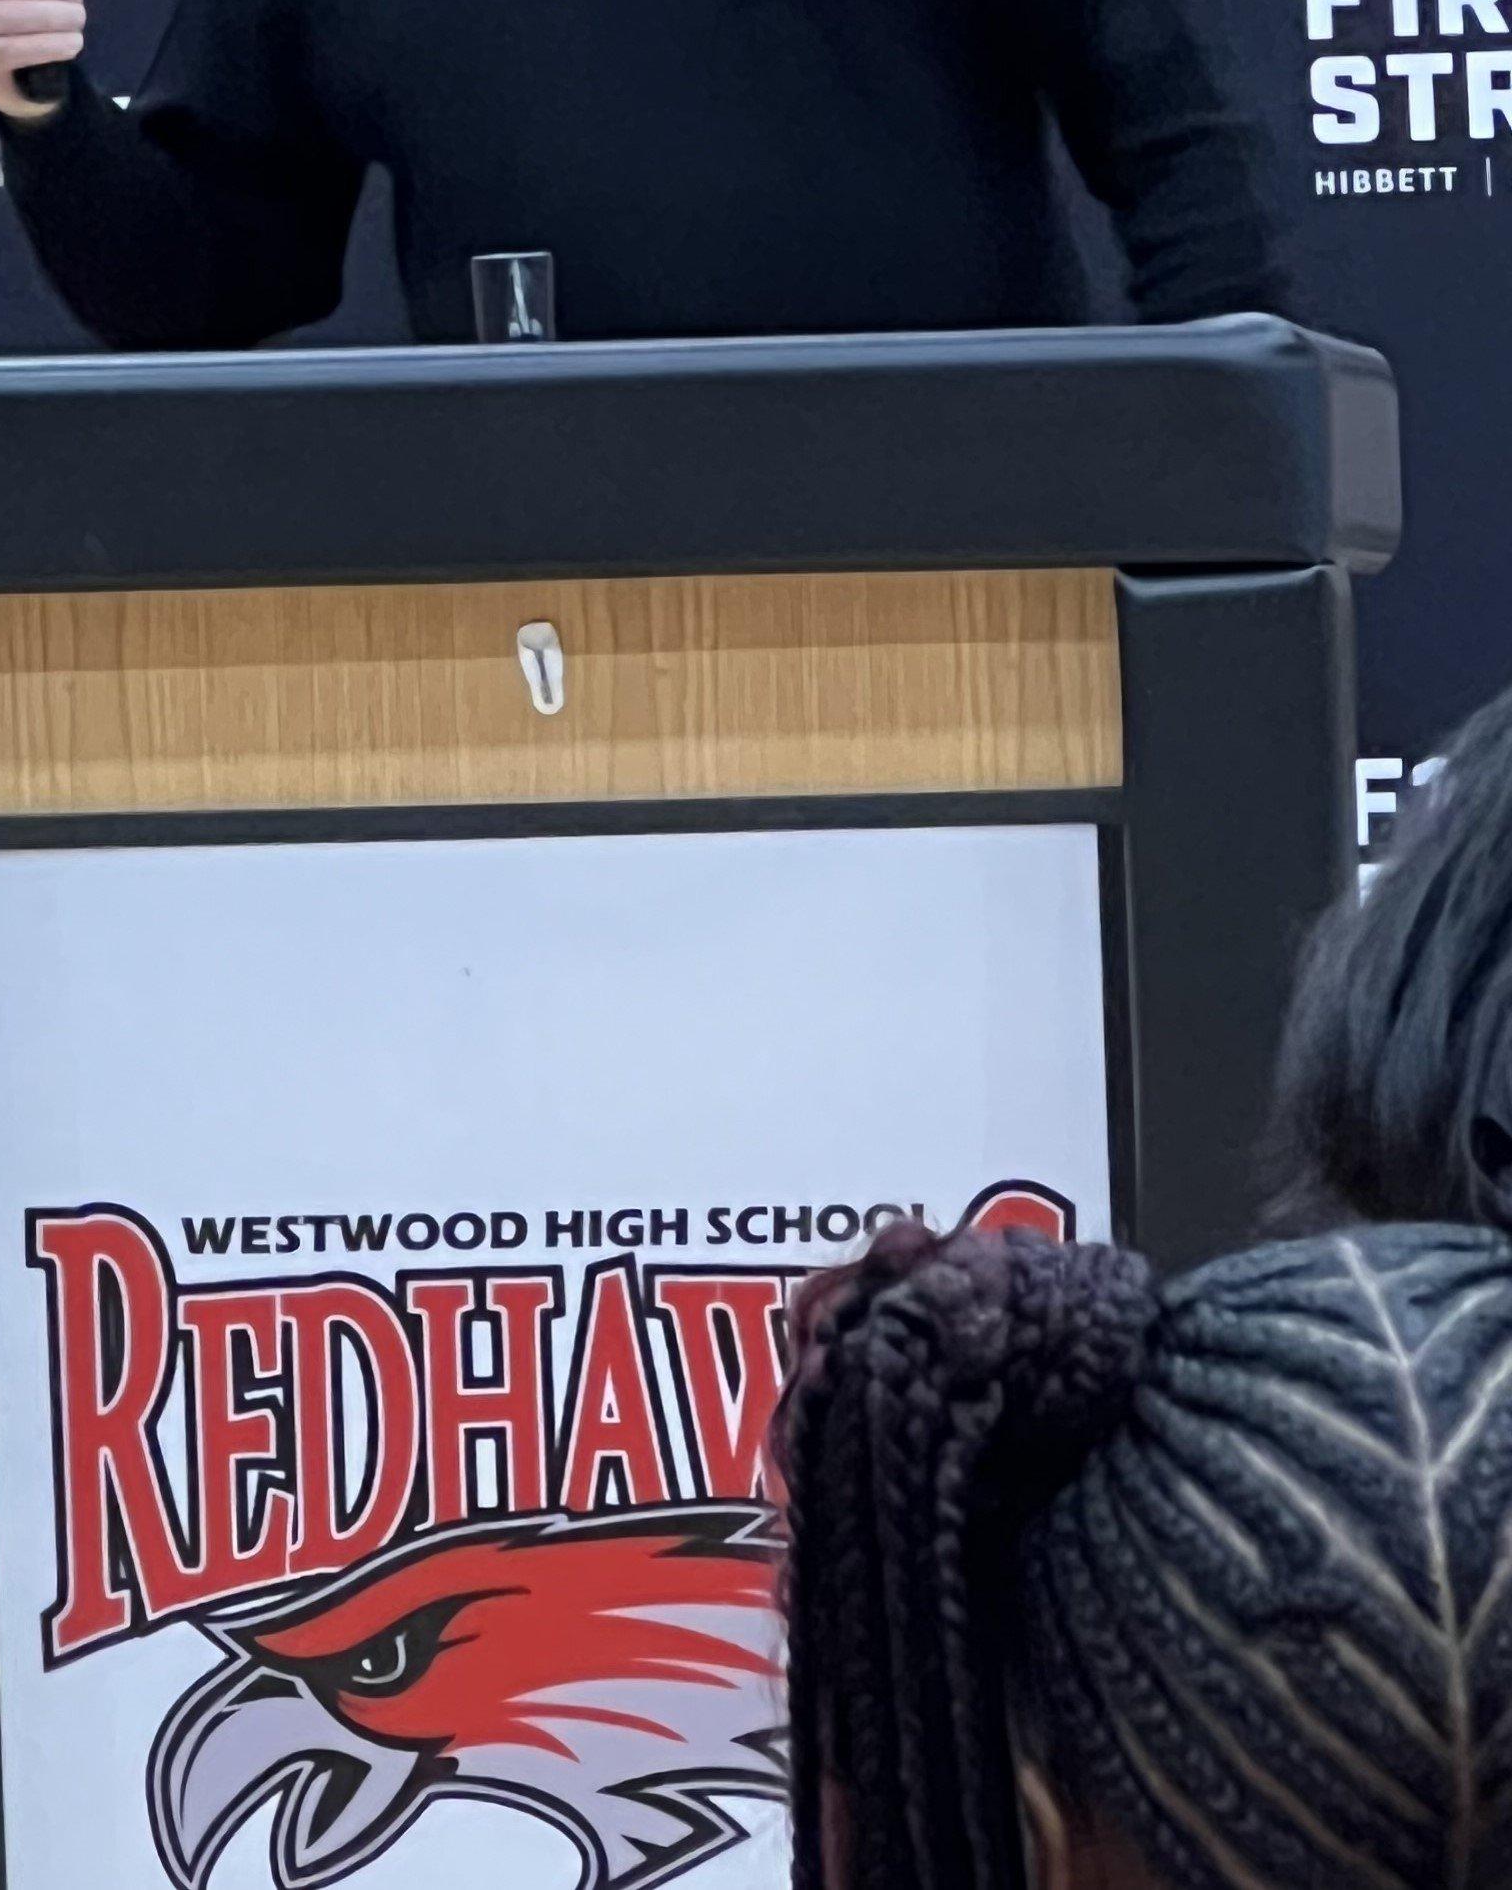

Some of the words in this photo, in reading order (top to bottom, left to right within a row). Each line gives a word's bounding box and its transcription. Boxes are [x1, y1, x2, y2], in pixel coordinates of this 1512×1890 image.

[1309, 50, 1512, 144] STR
[1315, 166, 1458, 195] HIBBETT
[181, 1211, 528, 1255] WESTWOOD
[545, 1208, 689, 1248] HIGH
[26, 1179, 1076, 1672] REDHAW
